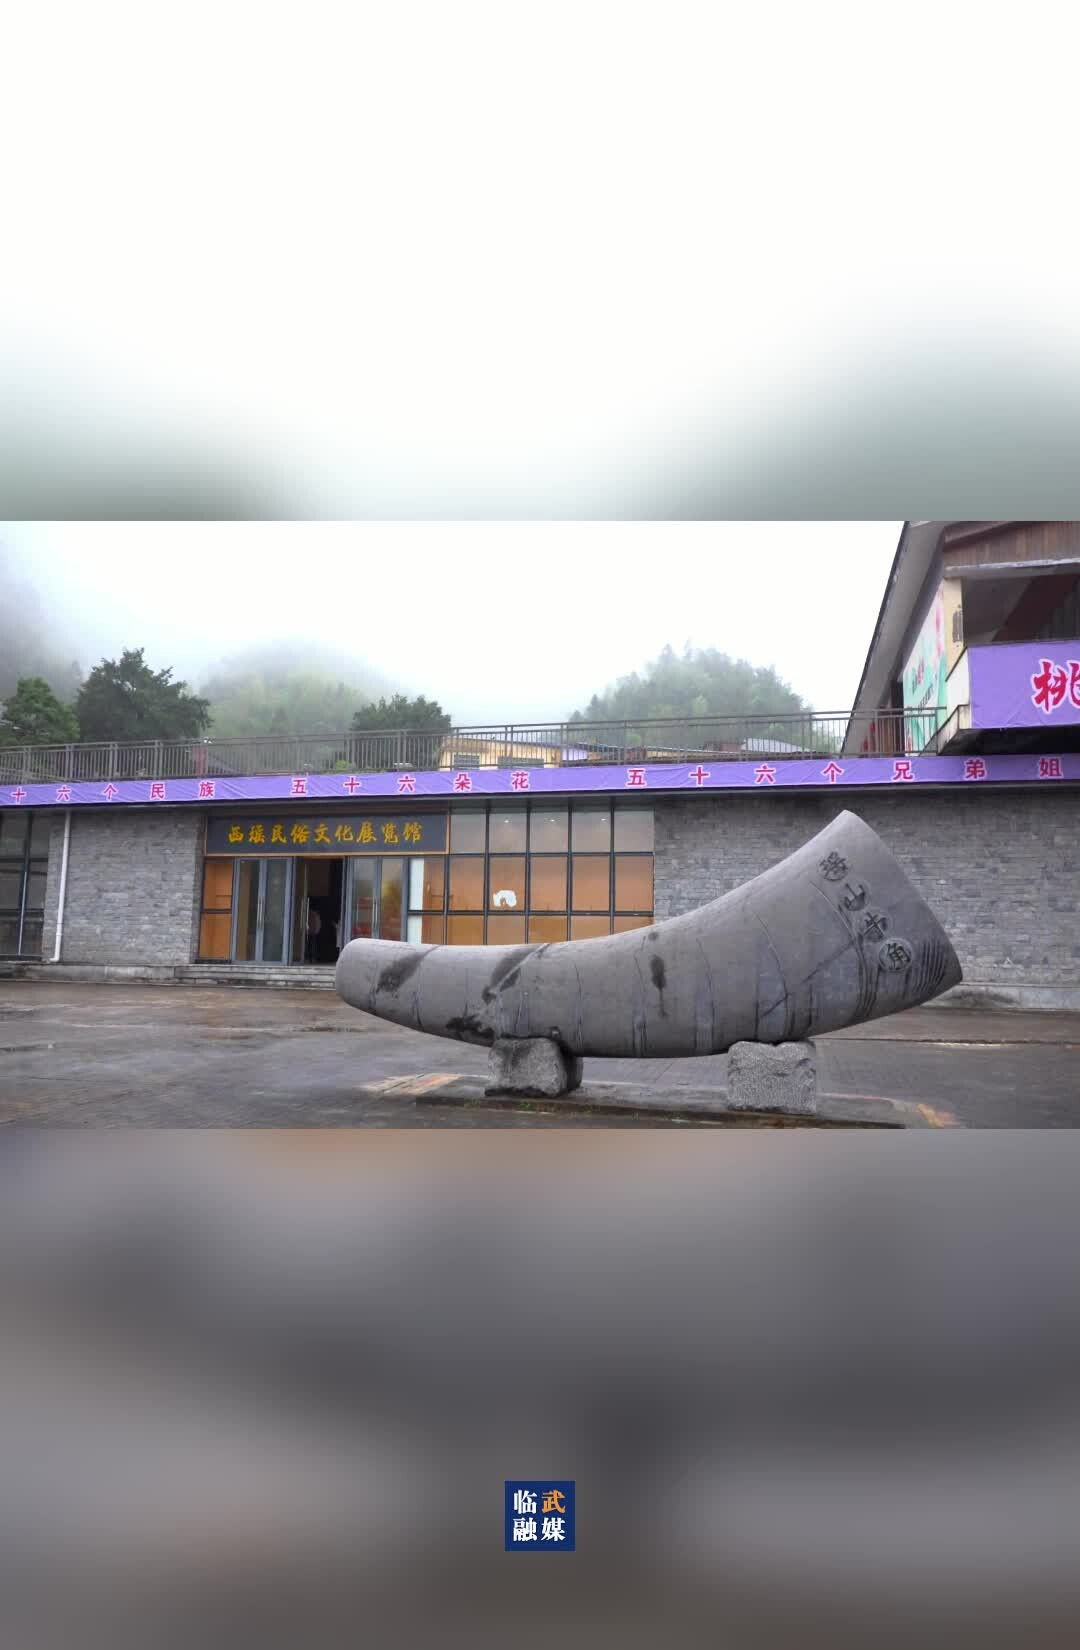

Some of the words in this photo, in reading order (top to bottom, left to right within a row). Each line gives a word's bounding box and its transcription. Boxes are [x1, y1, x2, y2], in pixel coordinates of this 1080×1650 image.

[10, 779, 216, 806] 十六个民族
[290, 772, 531, 796] 五十六朵花
[625, 756, 1064, 788] 五十六个兄弟姐
